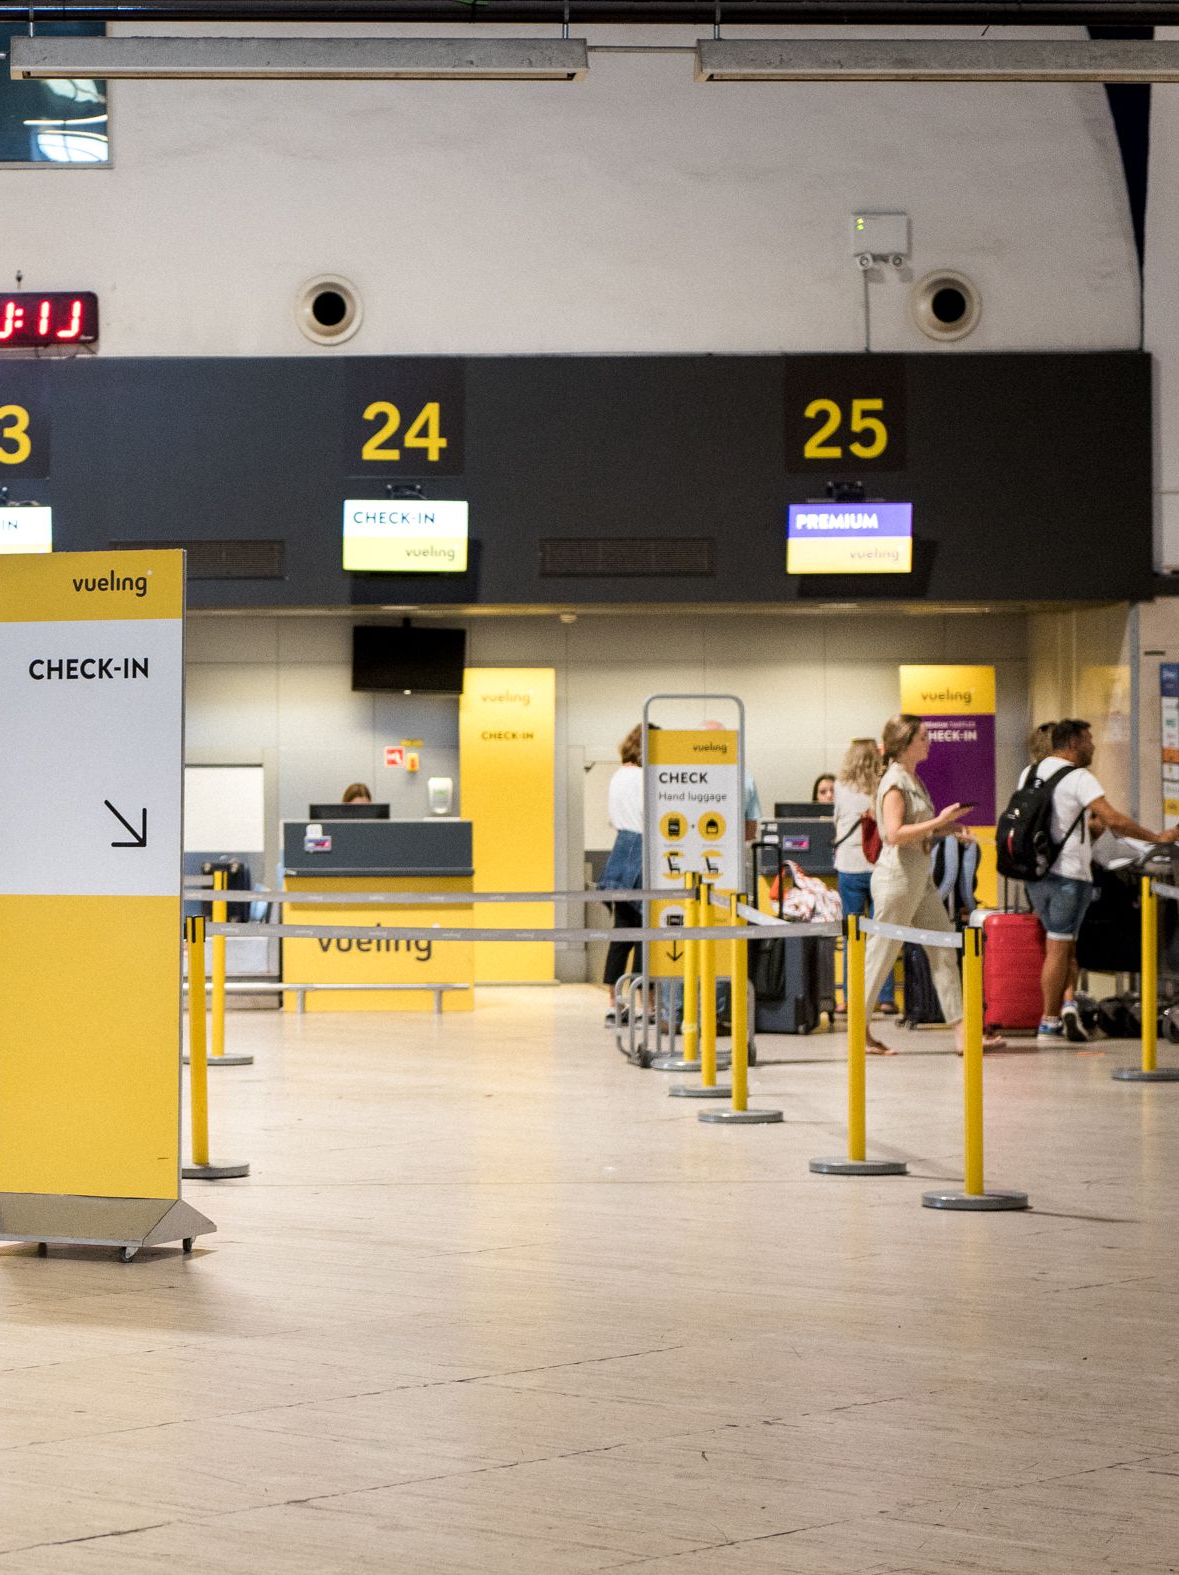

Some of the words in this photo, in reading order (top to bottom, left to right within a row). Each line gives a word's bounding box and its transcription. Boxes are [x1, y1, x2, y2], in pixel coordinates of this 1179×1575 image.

[361, 400, 448, 461] 24
[803, 398, 888, 459] 25
[353, 511, 436, 524] CHECK-IN
[795, 512, 879, 530] PREMIUM
[405, 545, 456, 561] vueling
[72, 569, 148, 598] vueling
[28, 657, 149, 680] CHECK-IN
[921, 687, 972, 704] vueling
[481, 731, 535, 740] CHECK-IN
[927, 730, 978, 741] HECK-IN
[692, 742, 728, 755] vueling
[658, 772, 709, 784] CHECK
[658, 791, 686, 801] Hand
[688, 791, 728, 804] luggage
